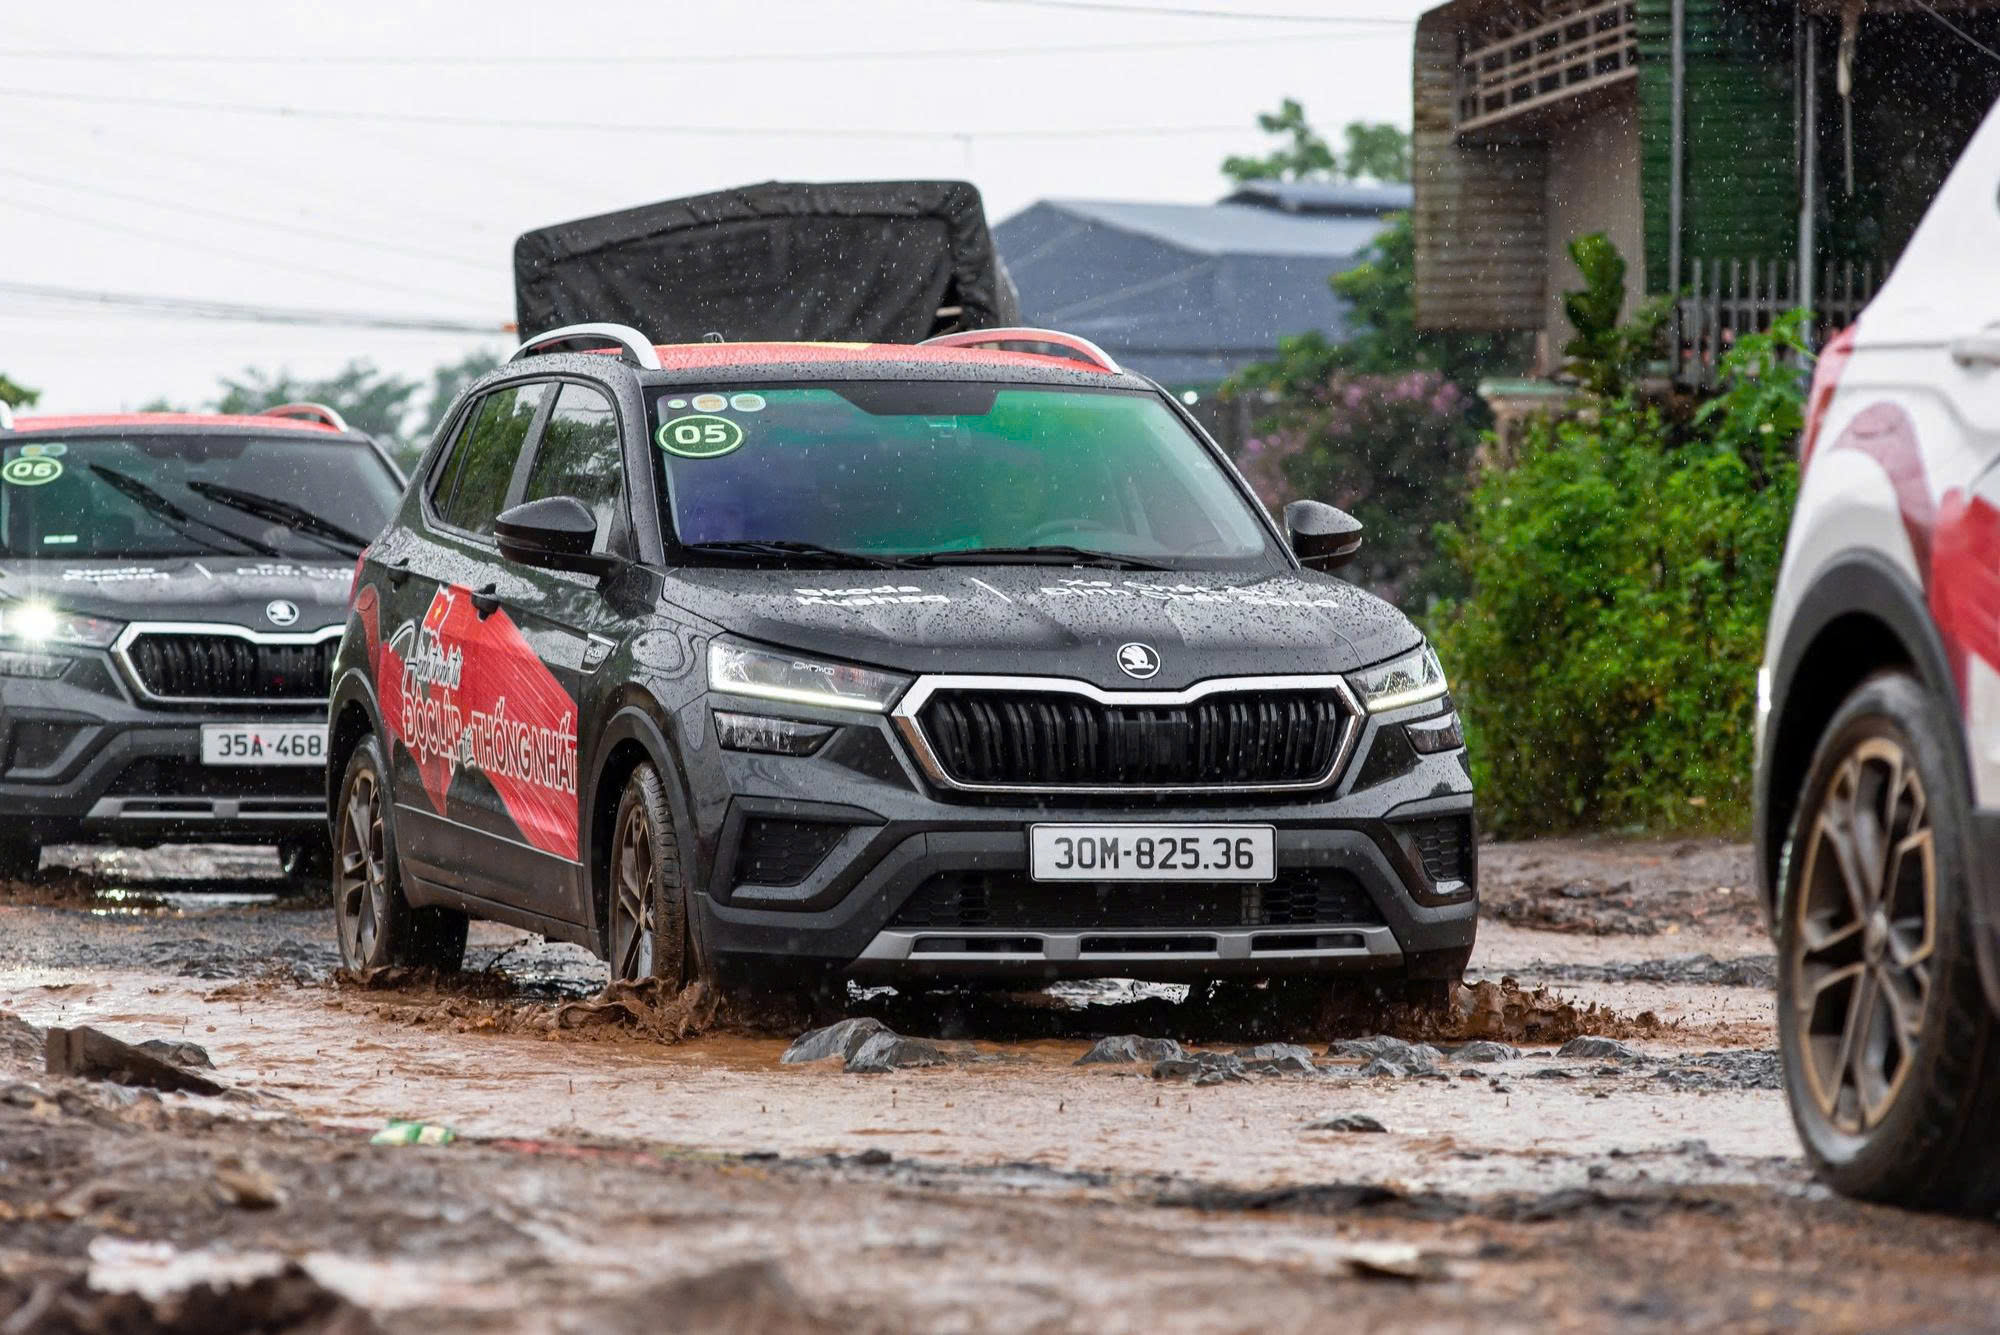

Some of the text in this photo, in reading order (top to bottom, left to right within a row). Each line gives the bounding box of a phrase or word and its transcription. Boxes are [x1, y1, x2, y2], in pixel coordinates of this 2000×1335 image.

[674, 423, 727, 445] 05
[12, 462, 52, 477] 06
[793, 585, 922, 596] Skoda
[218, 734, 328, 757] 35A-468.
[402, 682, 438, 765] ĐỘC
[435, 688, 462, 776] LẬP
[471, 695, 532, 783] THỐNG
[531, 710, 577, 795] NHẤT
[1054, 836, 1255, 870] 30M-825.36
